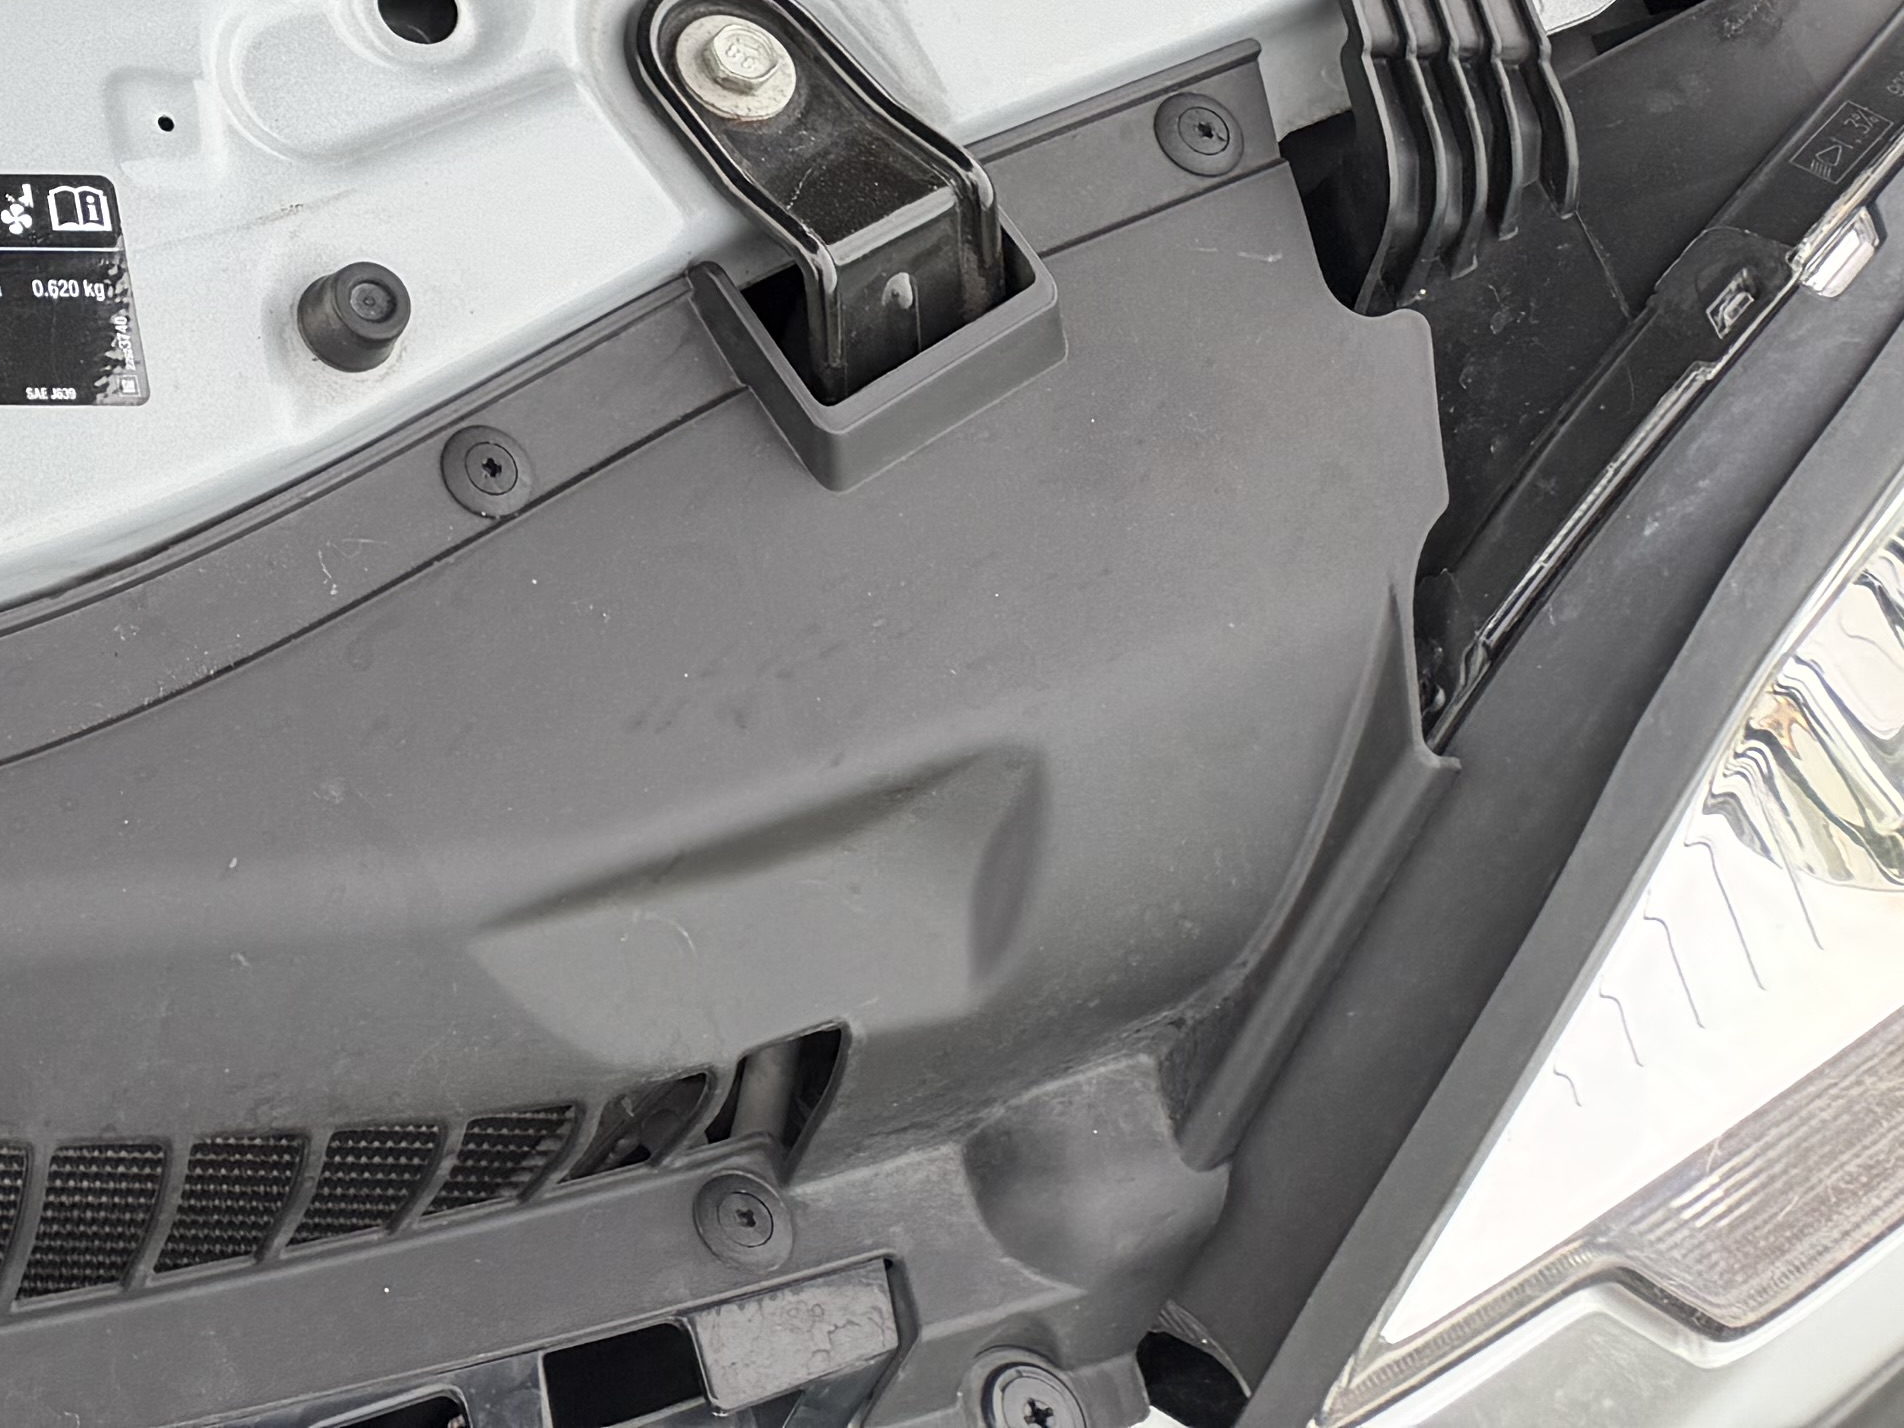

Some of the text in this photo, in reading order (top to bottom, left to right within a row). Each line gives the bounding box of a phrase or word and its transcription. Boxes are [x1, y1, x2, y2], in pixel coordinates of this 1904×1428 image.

[31, 279, 80, 299] 0.620
[83, 279, 106, 301] kg
[26, 387, 49, 401] SAE
